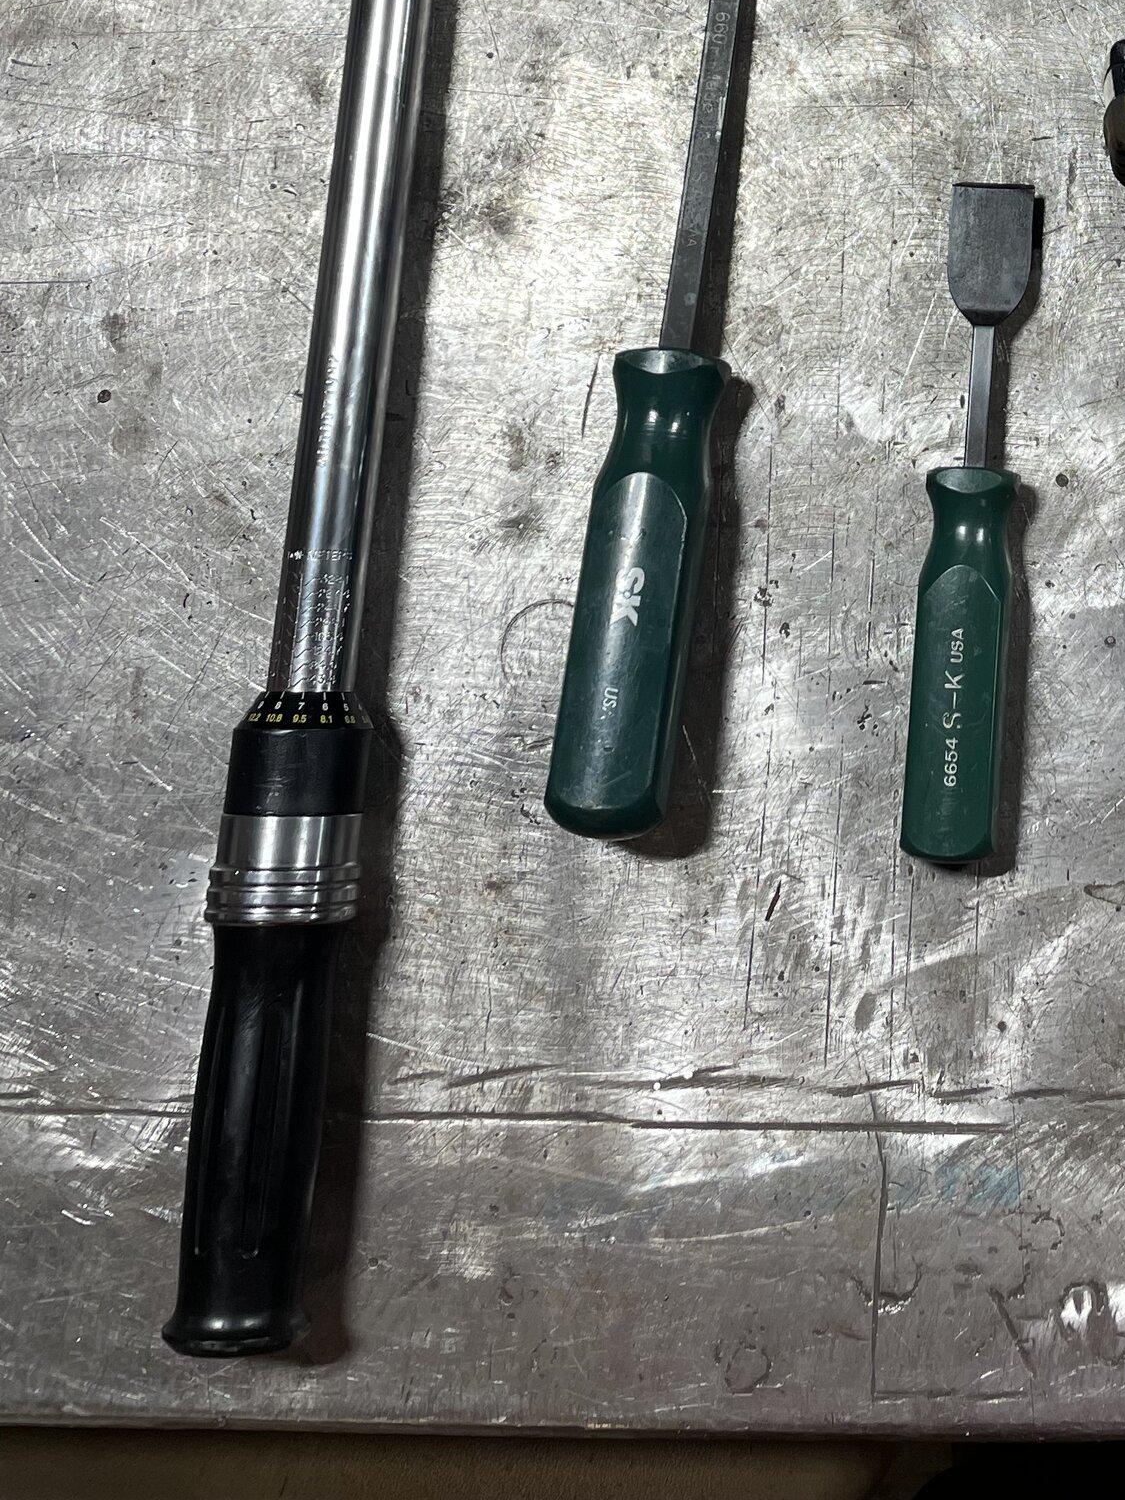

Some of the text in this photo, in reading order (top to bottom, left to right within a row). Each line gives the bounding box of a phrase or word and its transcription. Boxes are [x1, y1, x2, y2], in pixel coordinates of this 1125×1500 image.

[950, 628, 965, 663] USA
[298, 702, 306, 710] 7
[322, 703, 329, 711] 6
[343, 703, 350, 711] 5
[292, 714, 308, 723] 9.5
[320, 715, 333, 723] 8.1
[943, 737, 959, 787] 6654
